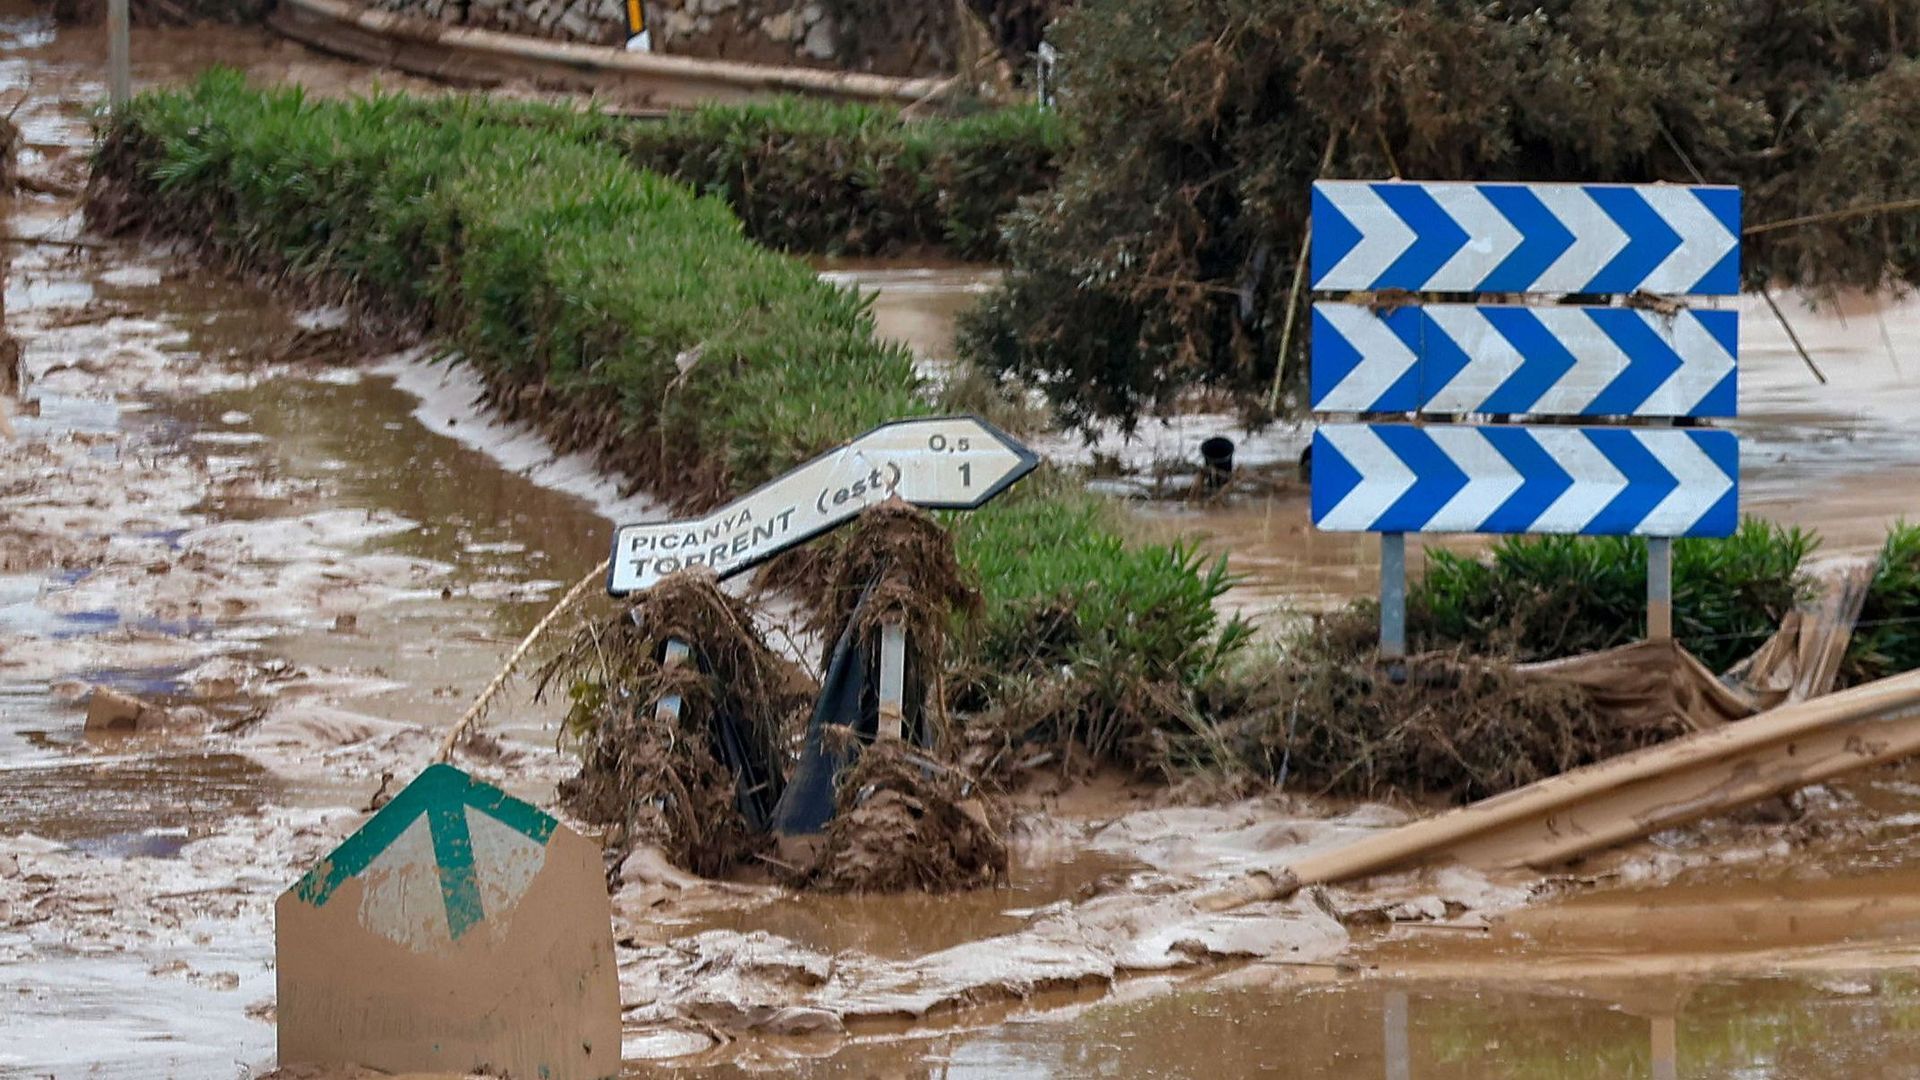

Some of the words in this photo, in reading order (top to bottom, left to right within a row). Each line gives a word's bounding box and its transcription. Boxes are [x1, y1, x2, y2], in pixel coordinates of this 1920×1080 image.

[631, 509, 752, 551] PICANYA
[928, 434, 970, 453] 0,5
[816, 461, 901, 514] (est)
[958, 461, 971, 487] 1
